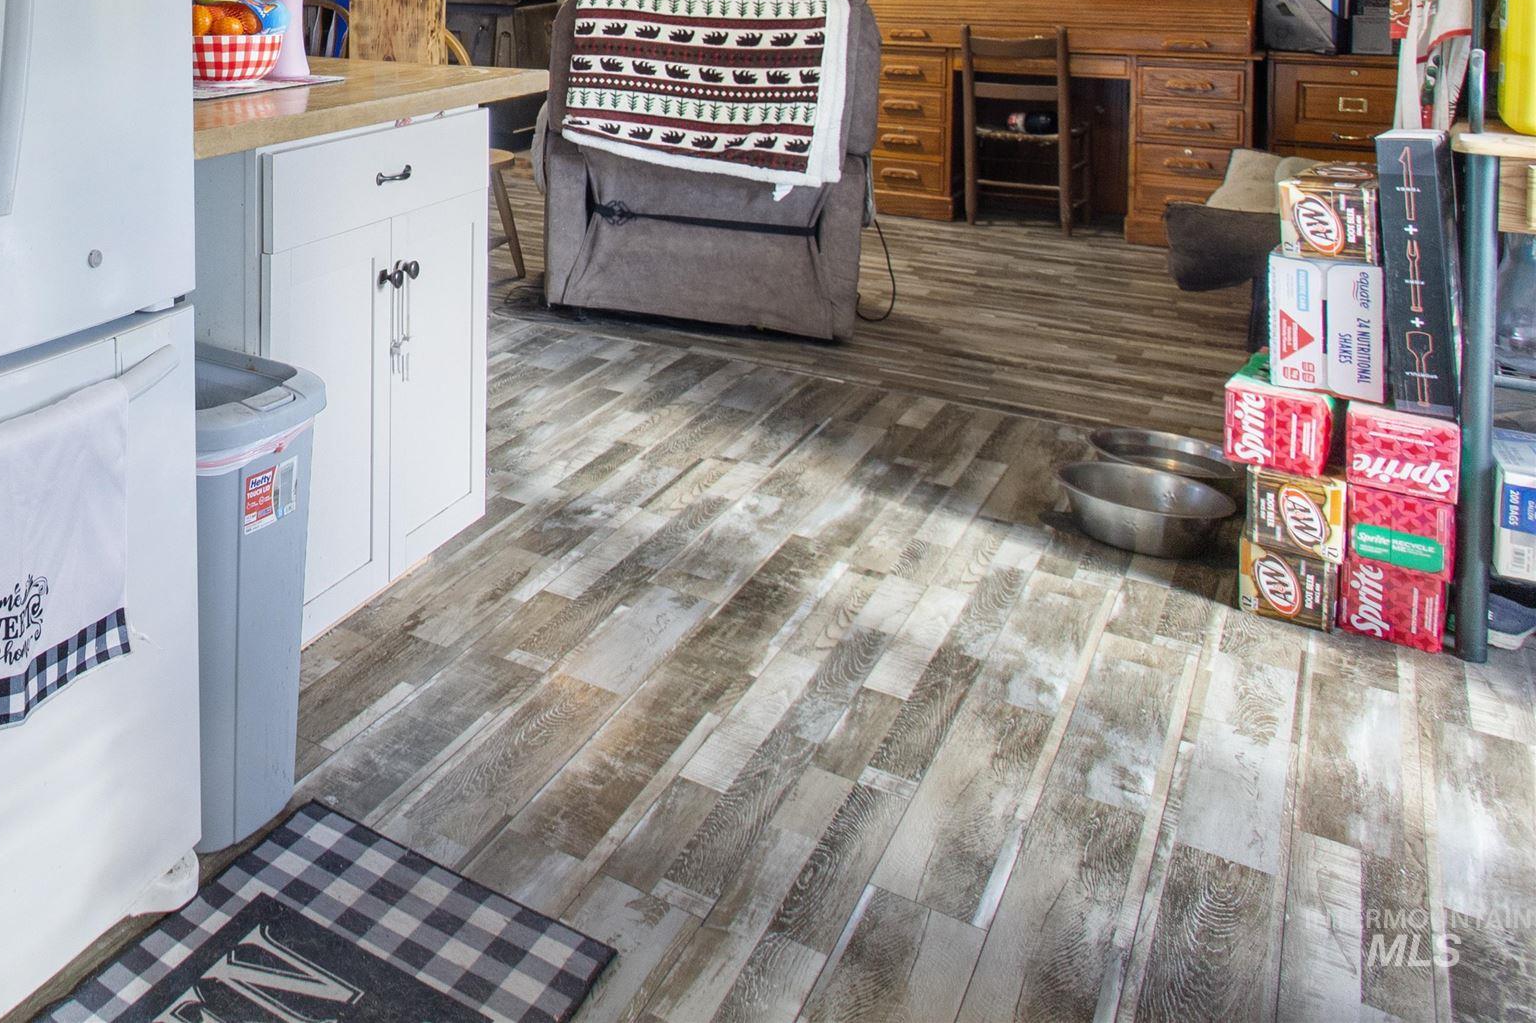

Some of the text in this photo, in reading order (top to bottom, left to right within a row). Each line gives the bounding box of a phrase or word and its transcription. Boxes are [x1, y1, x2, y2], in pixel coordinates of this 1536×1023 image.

[1356, 271, 1372, 310] equate
[1338, 332, 1353, 365] SHAKES
[1356, 317, 1372, 384] 24 NUTRITIONAL
[1234, 392, 1272, 464] Sprite
[250, 474, 271, 489] Hefty
[1352, 453, 1453, 493] Sprite
[1508, 489, 1520, 526] 200 BAGS
[1357, 531, 1391, 546] Sprite
[1391, 538, 1436, 554] RECYCLE
[1350, 563, 1390, 638] Sprite
